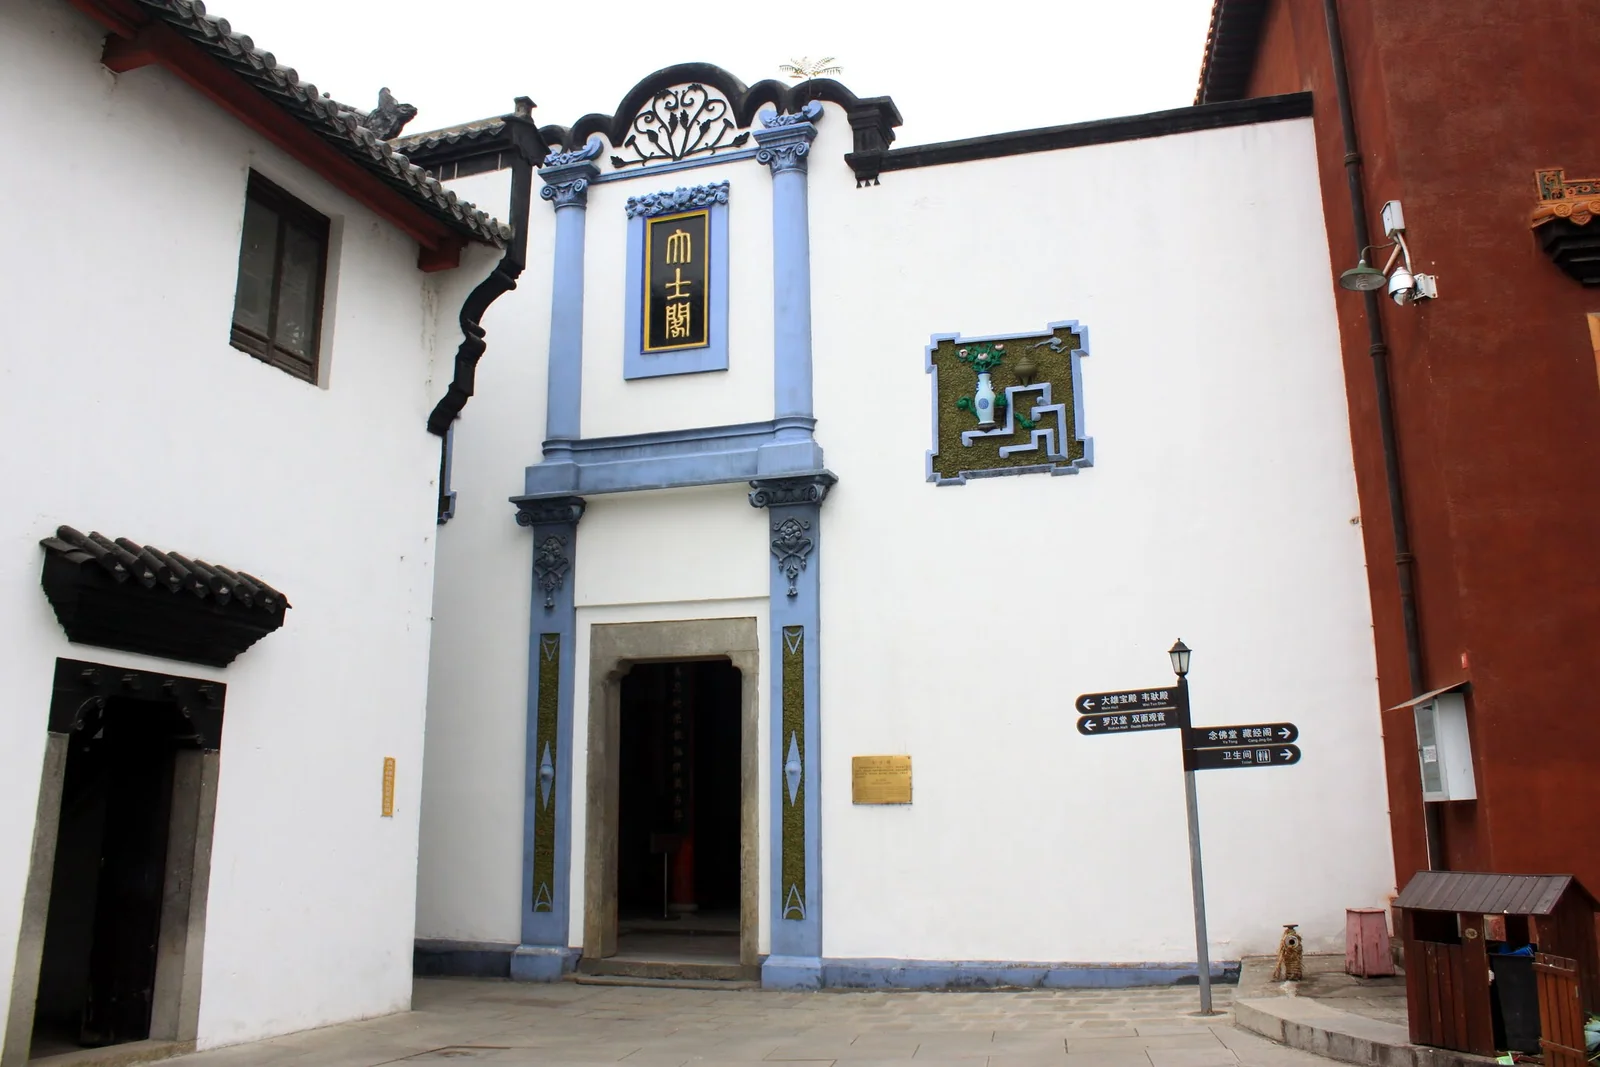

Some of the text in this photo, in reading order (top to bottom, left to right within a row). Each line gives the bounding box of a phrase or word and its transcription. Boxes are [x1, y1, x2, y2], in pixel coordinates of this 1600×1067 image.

[1101, 690, 1169, 706] 大雄宝殿 韦驮殿
[1102, 715, 1128, 726] 罗汉堂
[1131, 711, 1166, 724] 双面观音
[1208, 727, 1272, 741] 念佛堂 藏经阁
[1223, 750, 1252, 760] 卫生间
